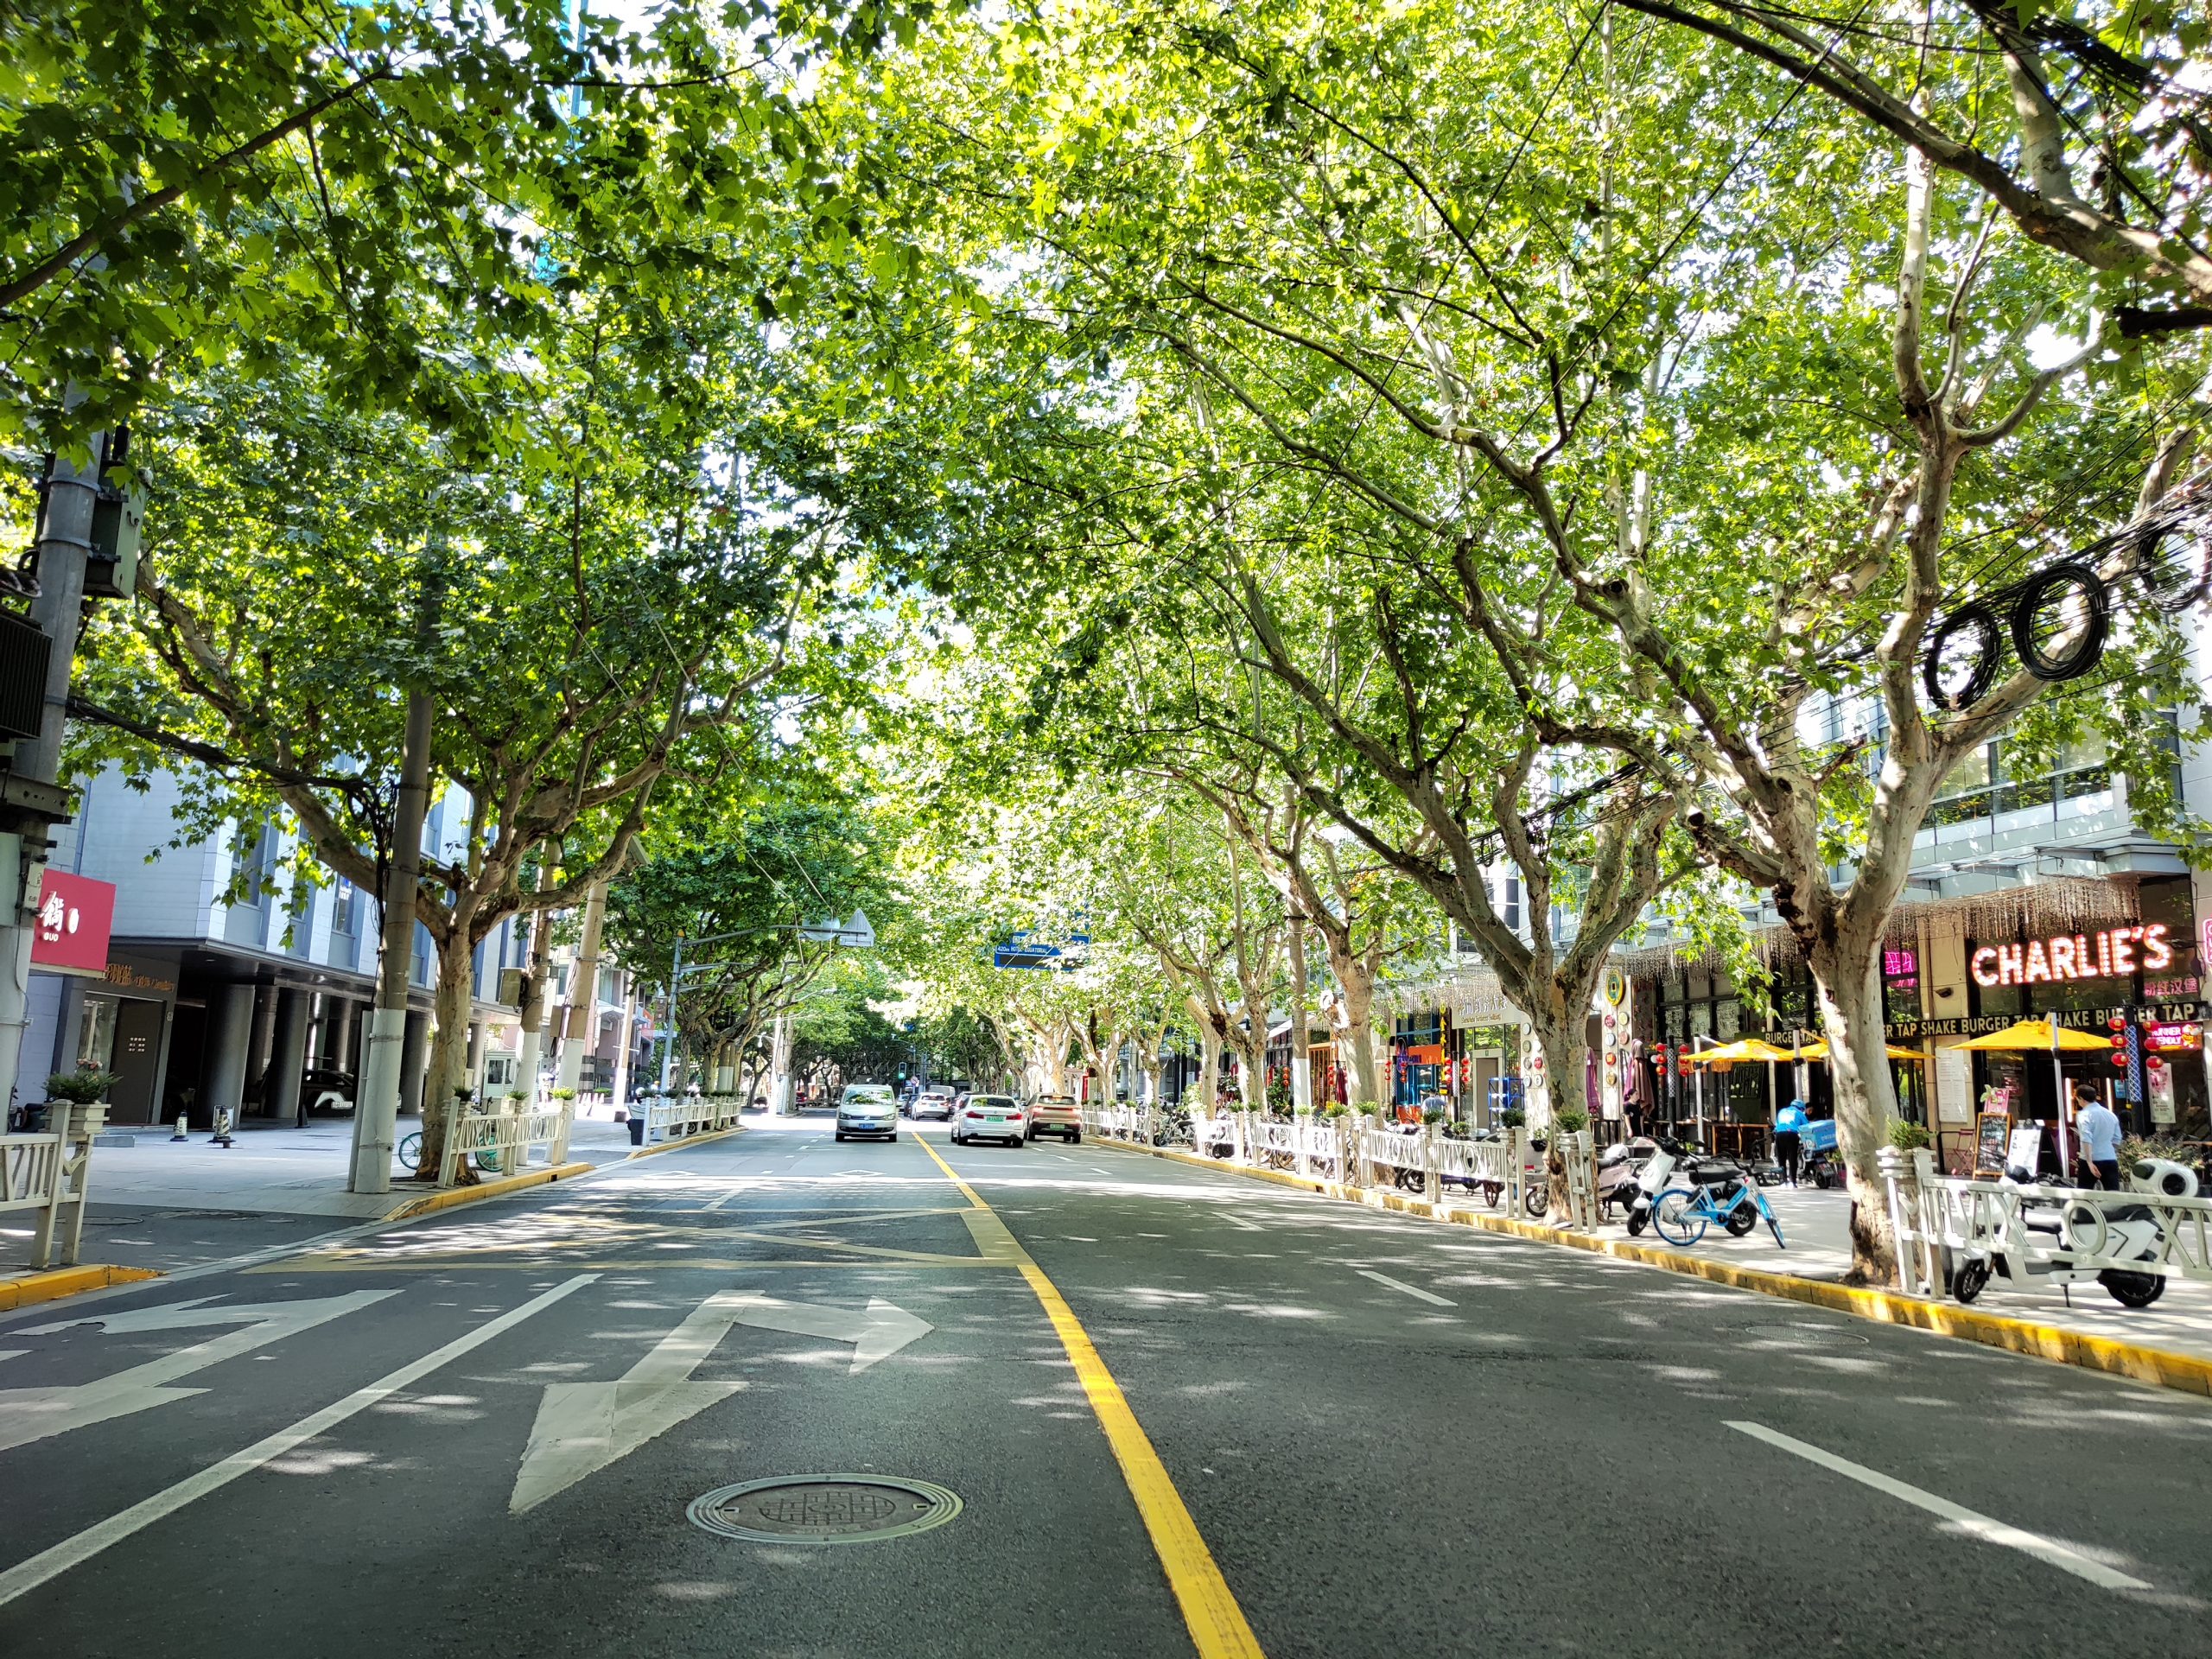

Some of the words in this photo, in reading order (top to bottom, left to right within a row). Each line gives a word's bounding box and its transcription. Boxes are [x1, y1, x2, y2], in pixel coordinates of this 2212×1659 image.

[43, 932, 59, 942] GUO
[1972, 924, 2171, 986] CHARLIE'S
[2144, 977, 2199, 996] 粉红汉堡
[1897, 1023, 1917, 1037] TAP
[1921, 1019, 1957, 1036] SHAKE
[1961, 1015, 2010, 1033] BURGER
[2162, 1003, 2194, 1021] TAP
